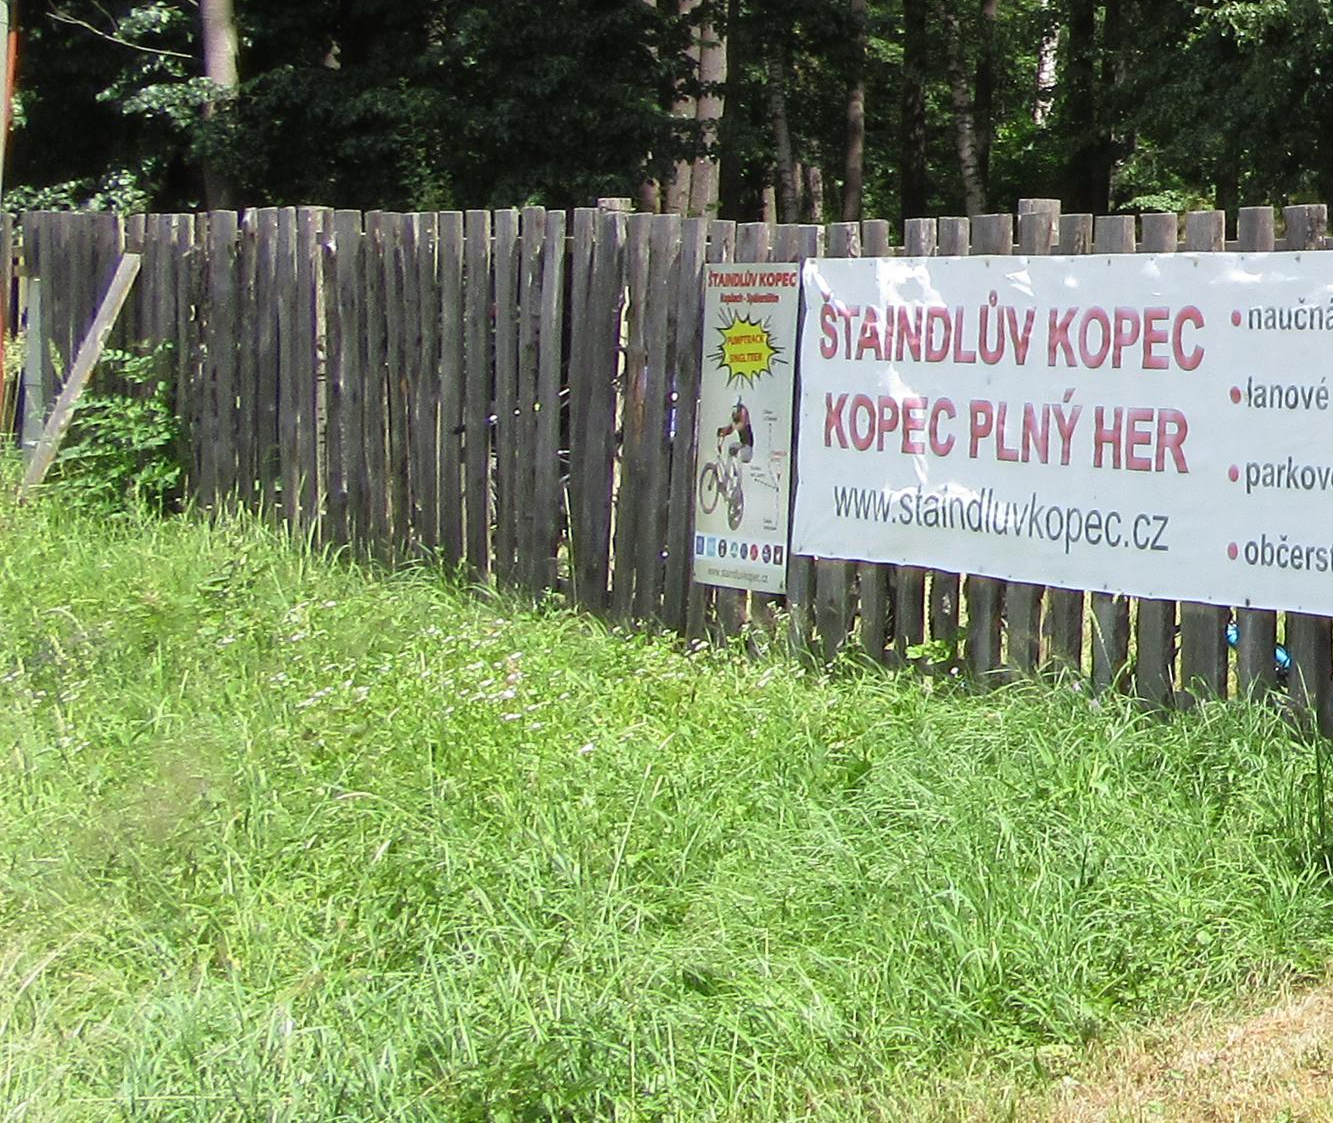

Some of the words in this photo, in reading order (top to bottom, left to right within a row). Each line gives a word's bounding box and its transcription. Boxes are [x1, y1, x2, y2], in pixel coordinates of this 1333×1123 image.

[760, 272, 797, 287] KOPEC
[819, 290, 1036, 366] ŠTAINDLŮV
[1047, 305, 1206, 371] KOPEC
[1247, 376, 1330, 411] lanové
[824, 392, 957, 458] KOPEC
[969, 388, 1083, 466] PLNÝ
[1093, 405, 1190, 474] HER
[834, 485, 1170, 554] www.staindluvkopec.cz
